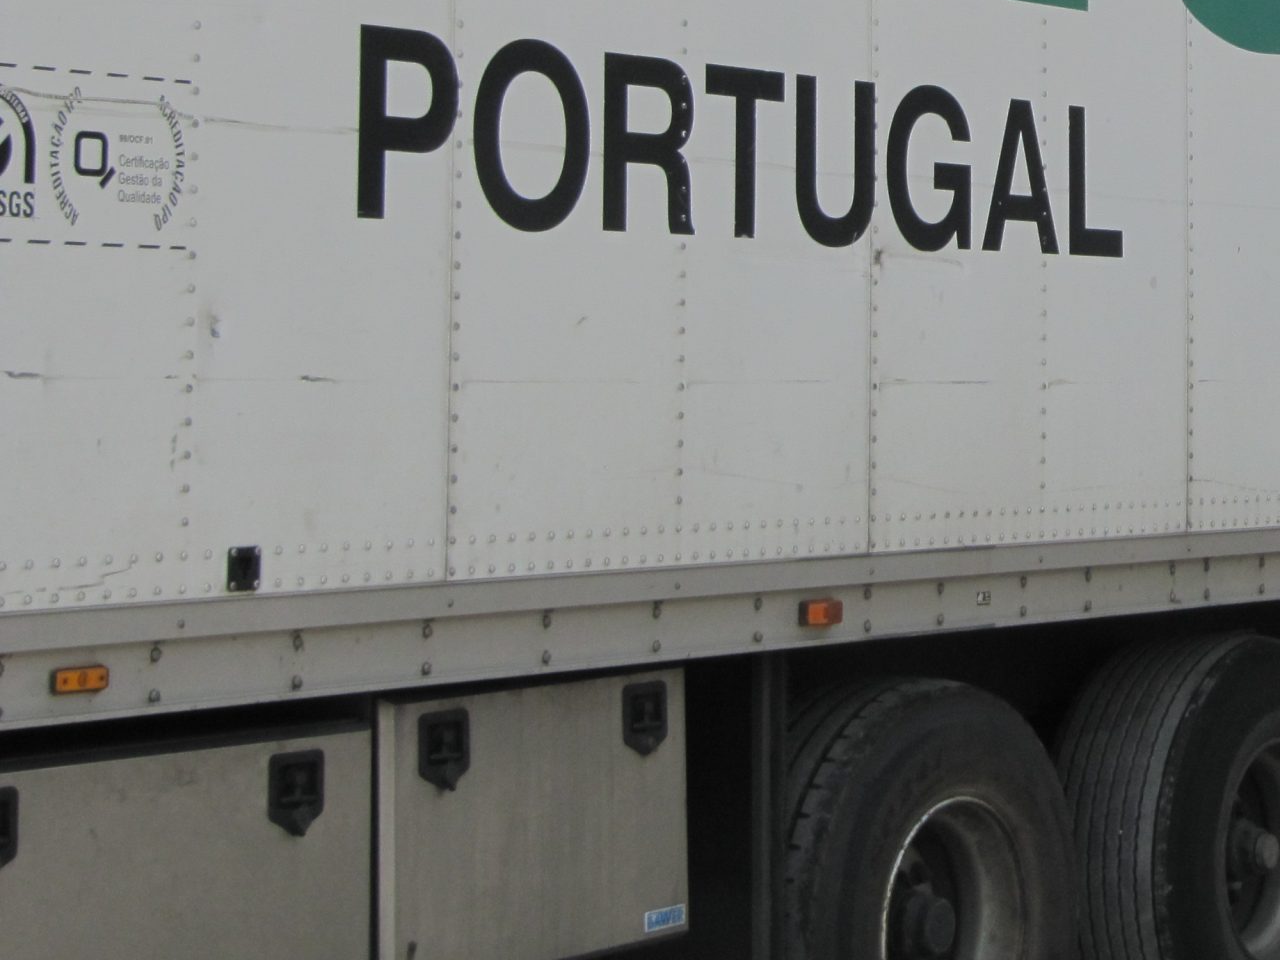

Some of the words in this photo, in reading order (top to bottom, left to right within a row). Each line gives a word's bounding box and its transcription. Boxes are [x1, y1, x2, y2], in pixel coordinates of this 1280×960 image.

[358, 25, 1122, 258] PORTUGAL
[119, 153, 169, 172] Certificação
[119, 172, 149, 186] Gestão
[152, 175, 162, 186] da
[118, 189, 161, 204] Qualidade
[153, 204, 173, 231] IPQ
